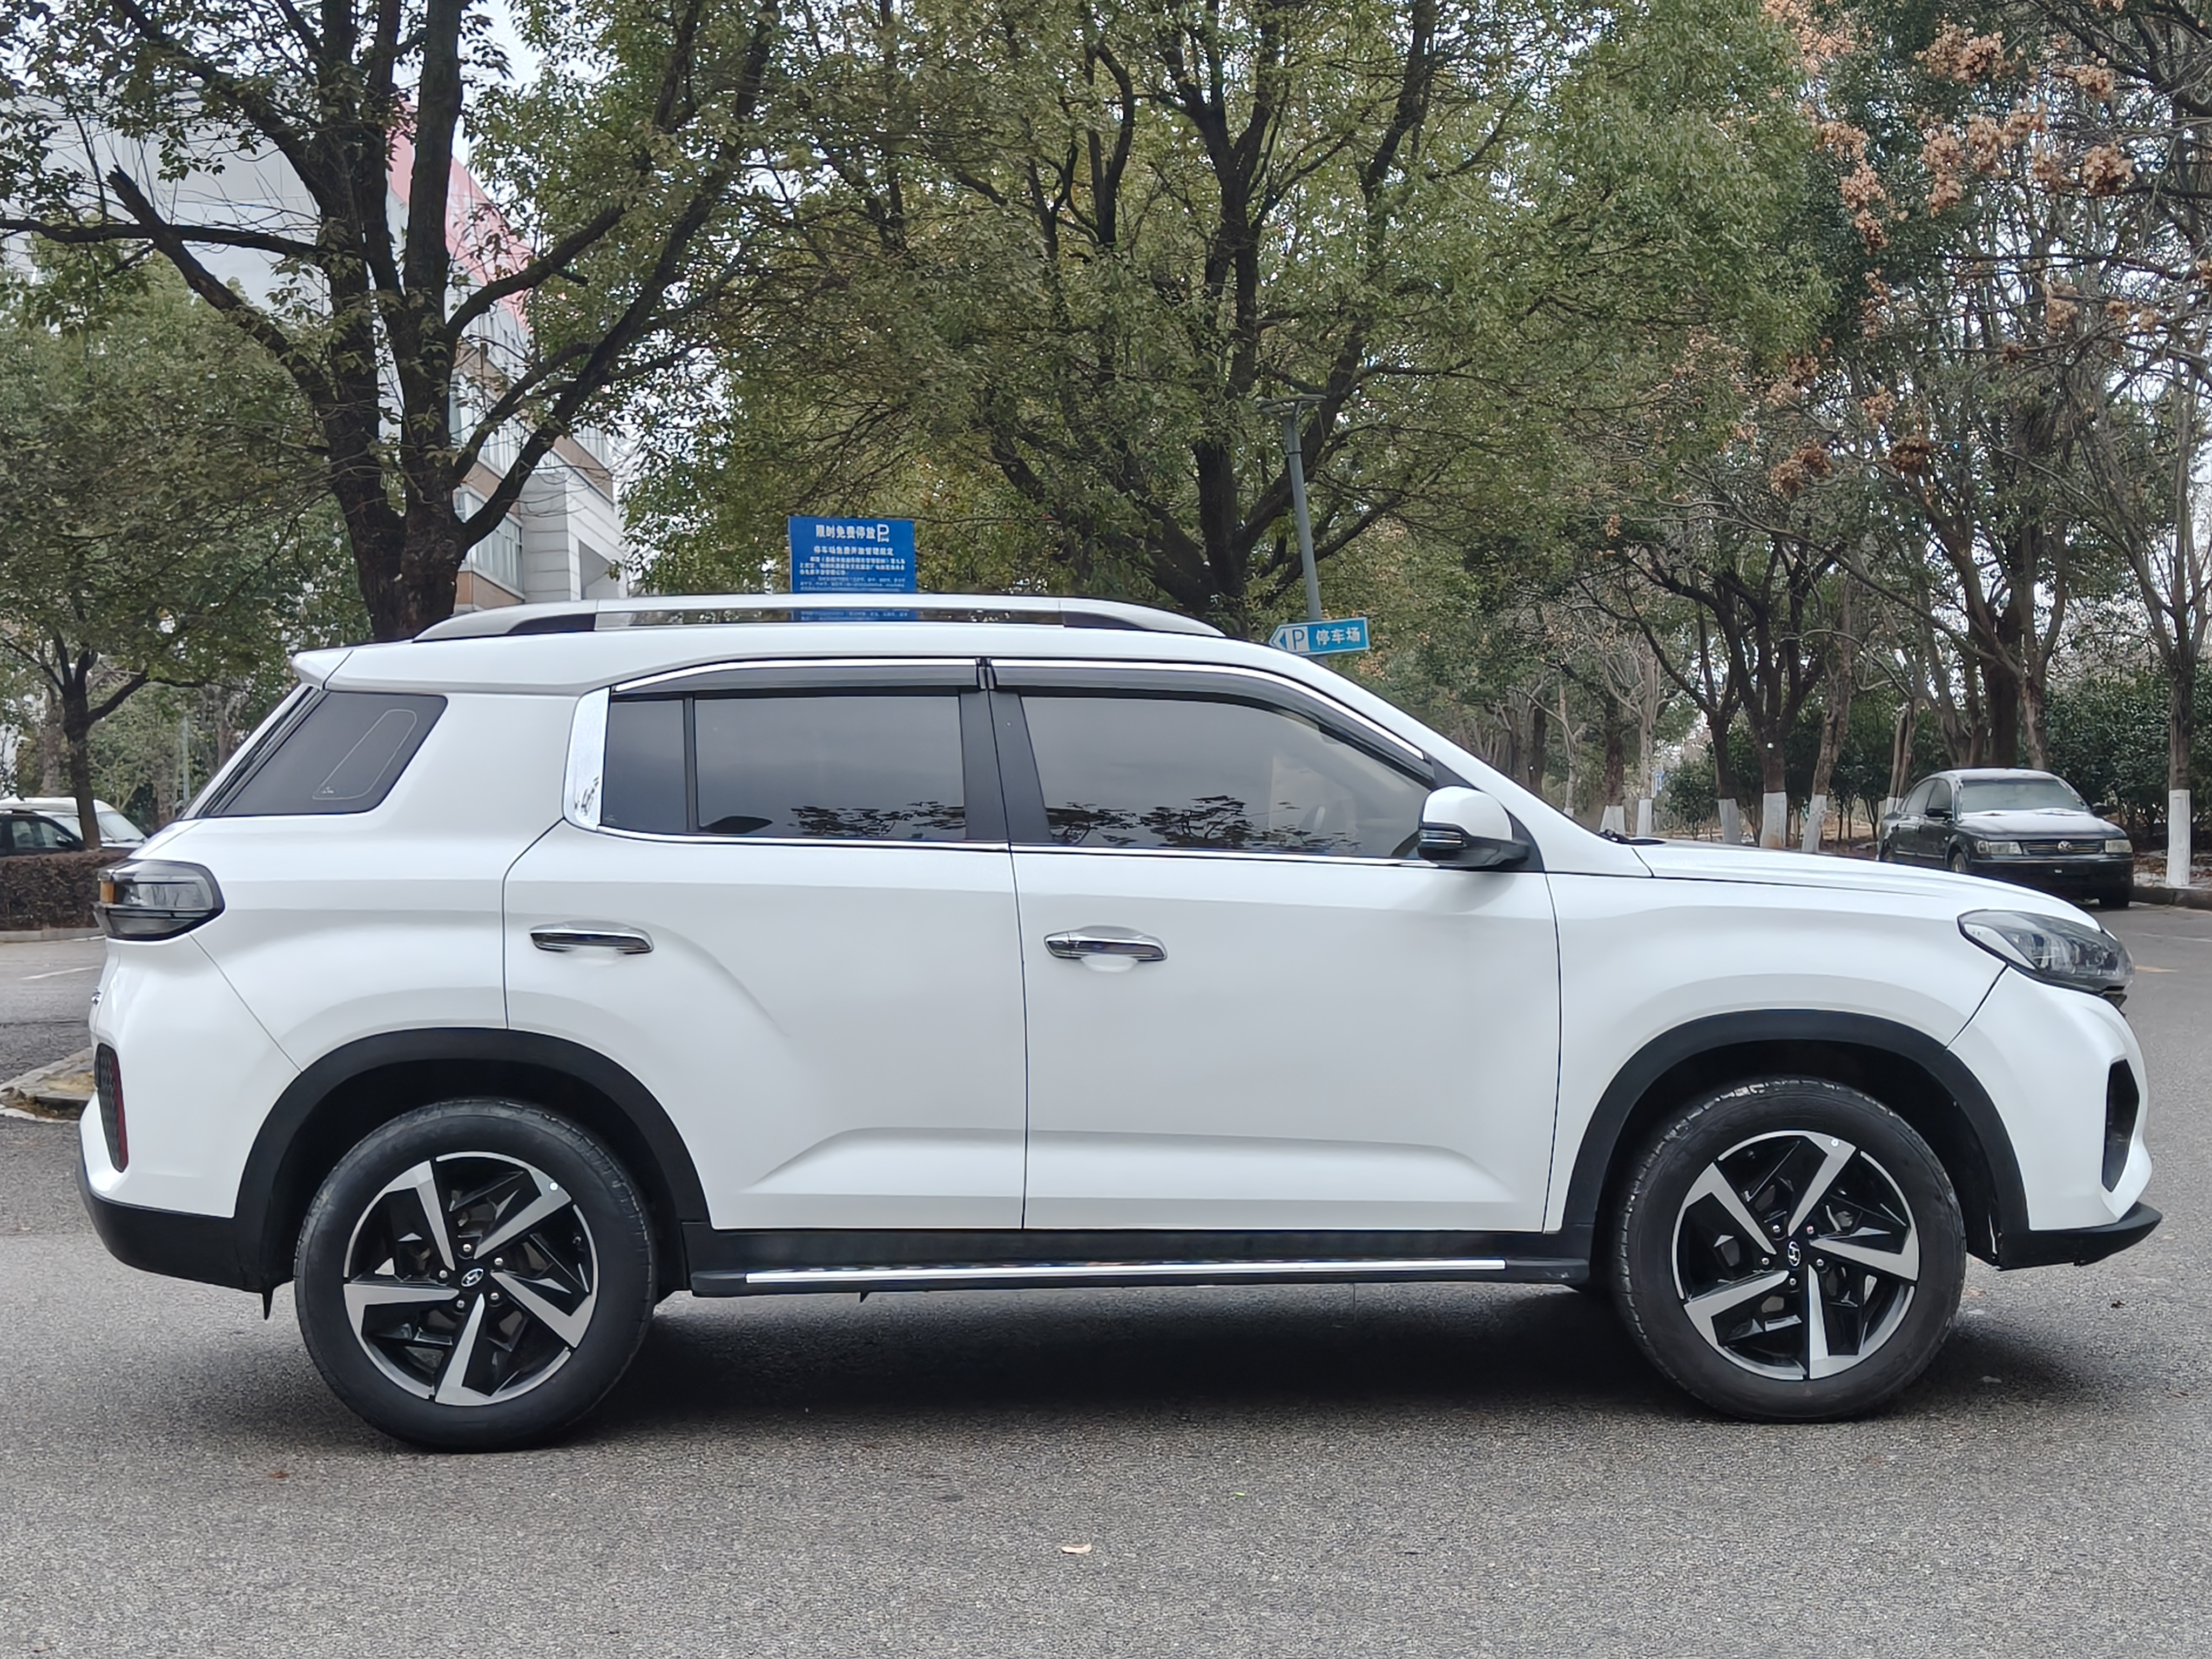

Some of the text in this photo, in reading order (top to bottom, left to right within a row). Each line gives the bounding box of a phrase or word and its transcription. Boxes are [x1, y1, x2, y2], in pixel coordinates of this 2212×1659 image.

[1292, 627, 1361, 650] P 停车场
